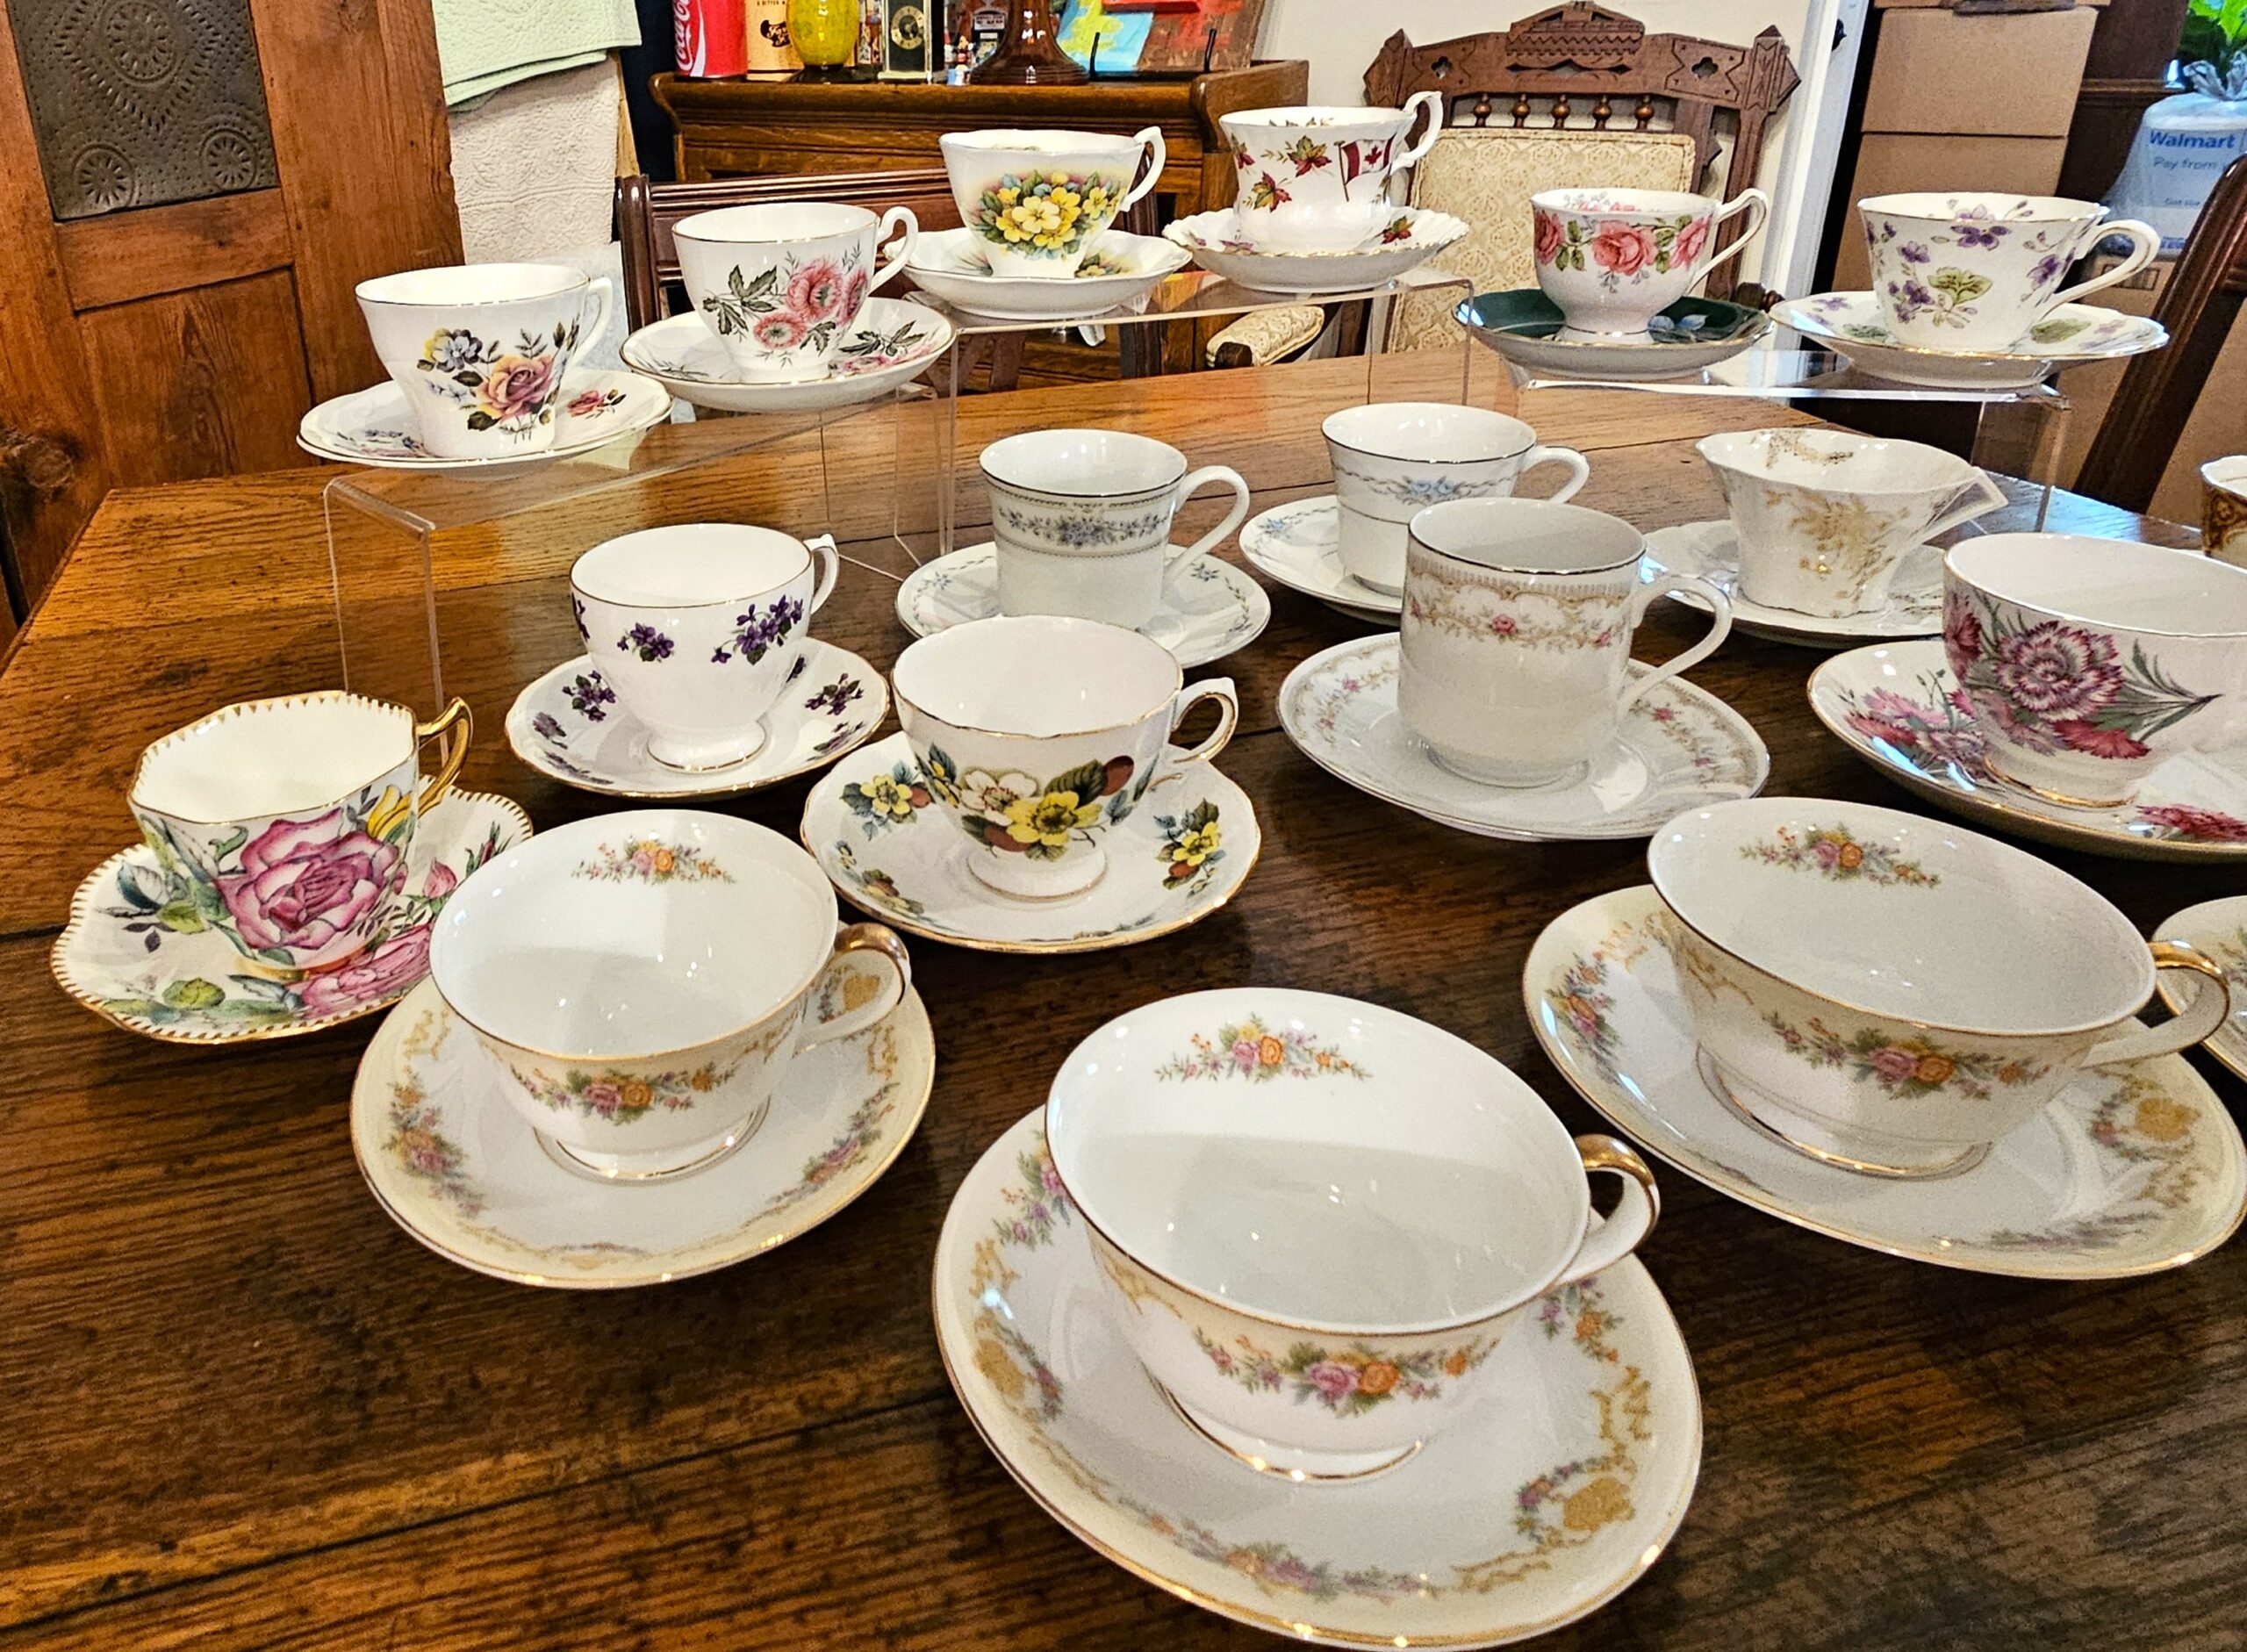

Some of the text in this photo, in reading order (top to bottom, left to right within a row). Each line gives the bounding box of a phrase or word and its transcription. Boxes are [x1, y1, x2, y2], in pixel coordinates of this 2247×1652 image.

[2150, 131, 2236, 149] Walmart
[2153, 156, 2177, 170] Pay
[2182, 158, 2217, 170] from
